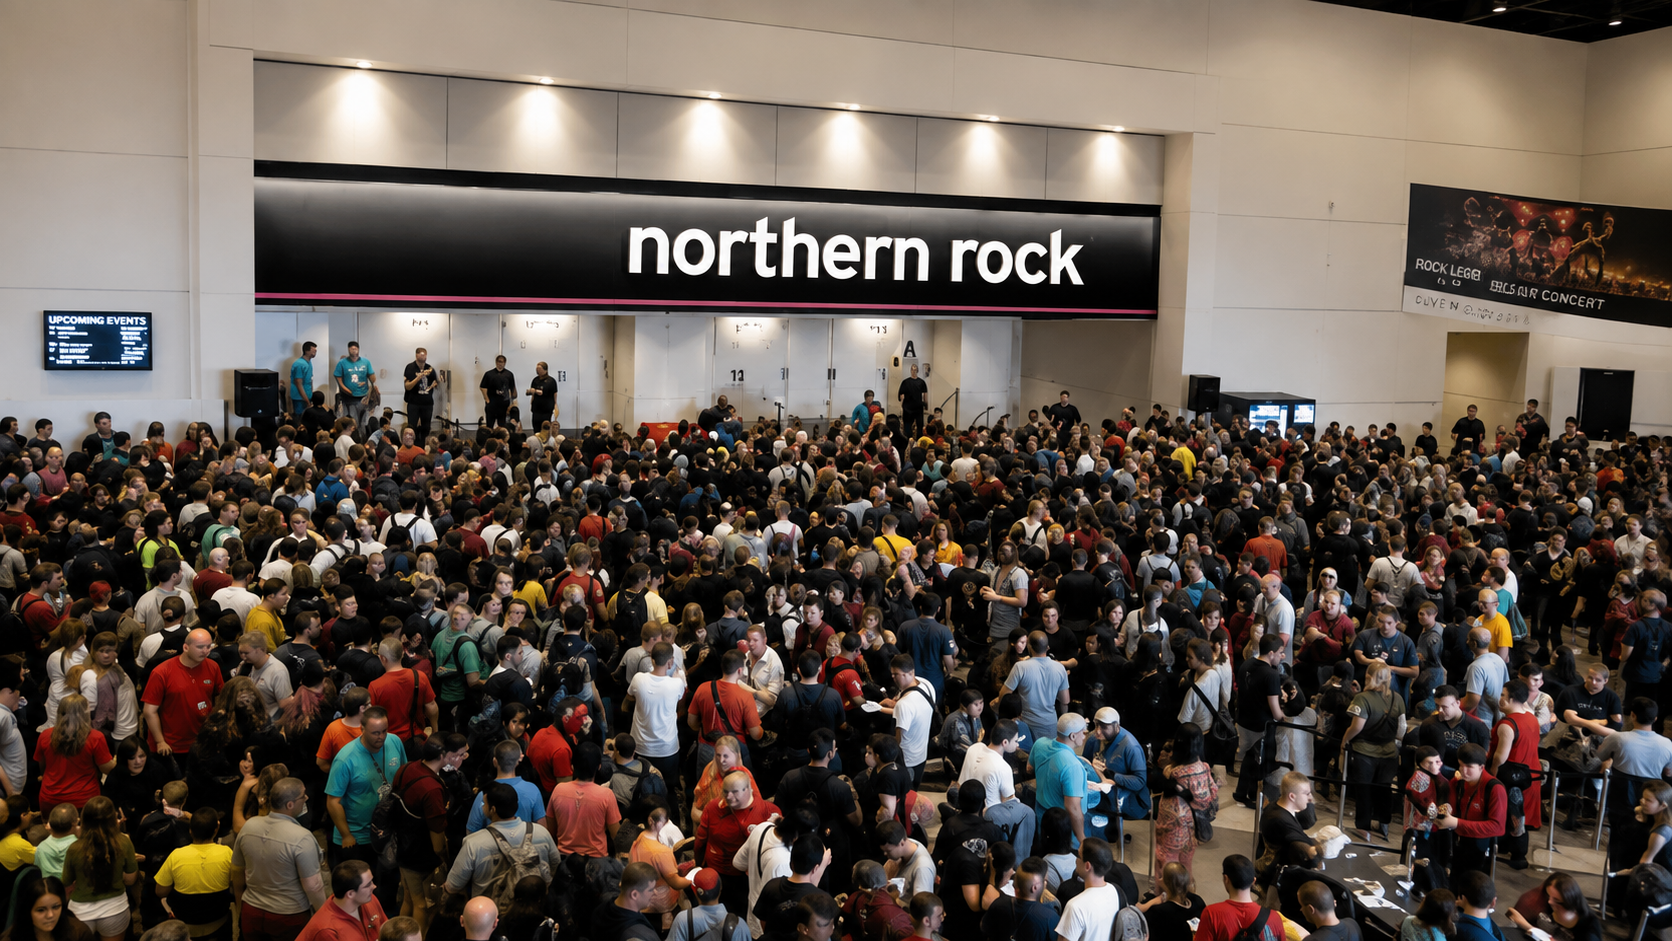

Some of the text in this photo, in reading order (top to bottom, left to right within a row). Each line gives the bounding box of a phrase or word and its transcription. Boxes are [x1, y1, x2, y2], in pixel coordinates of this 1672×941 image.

[628, 216, 1085, 286] northern rock
[1415, 258, 1449, 275] ROCK
[1541, 290, 1605, 310] CONCERT
[48, 315, 146, 325] UPCOMING EVENTS
[903, 340, 917, 358] A
